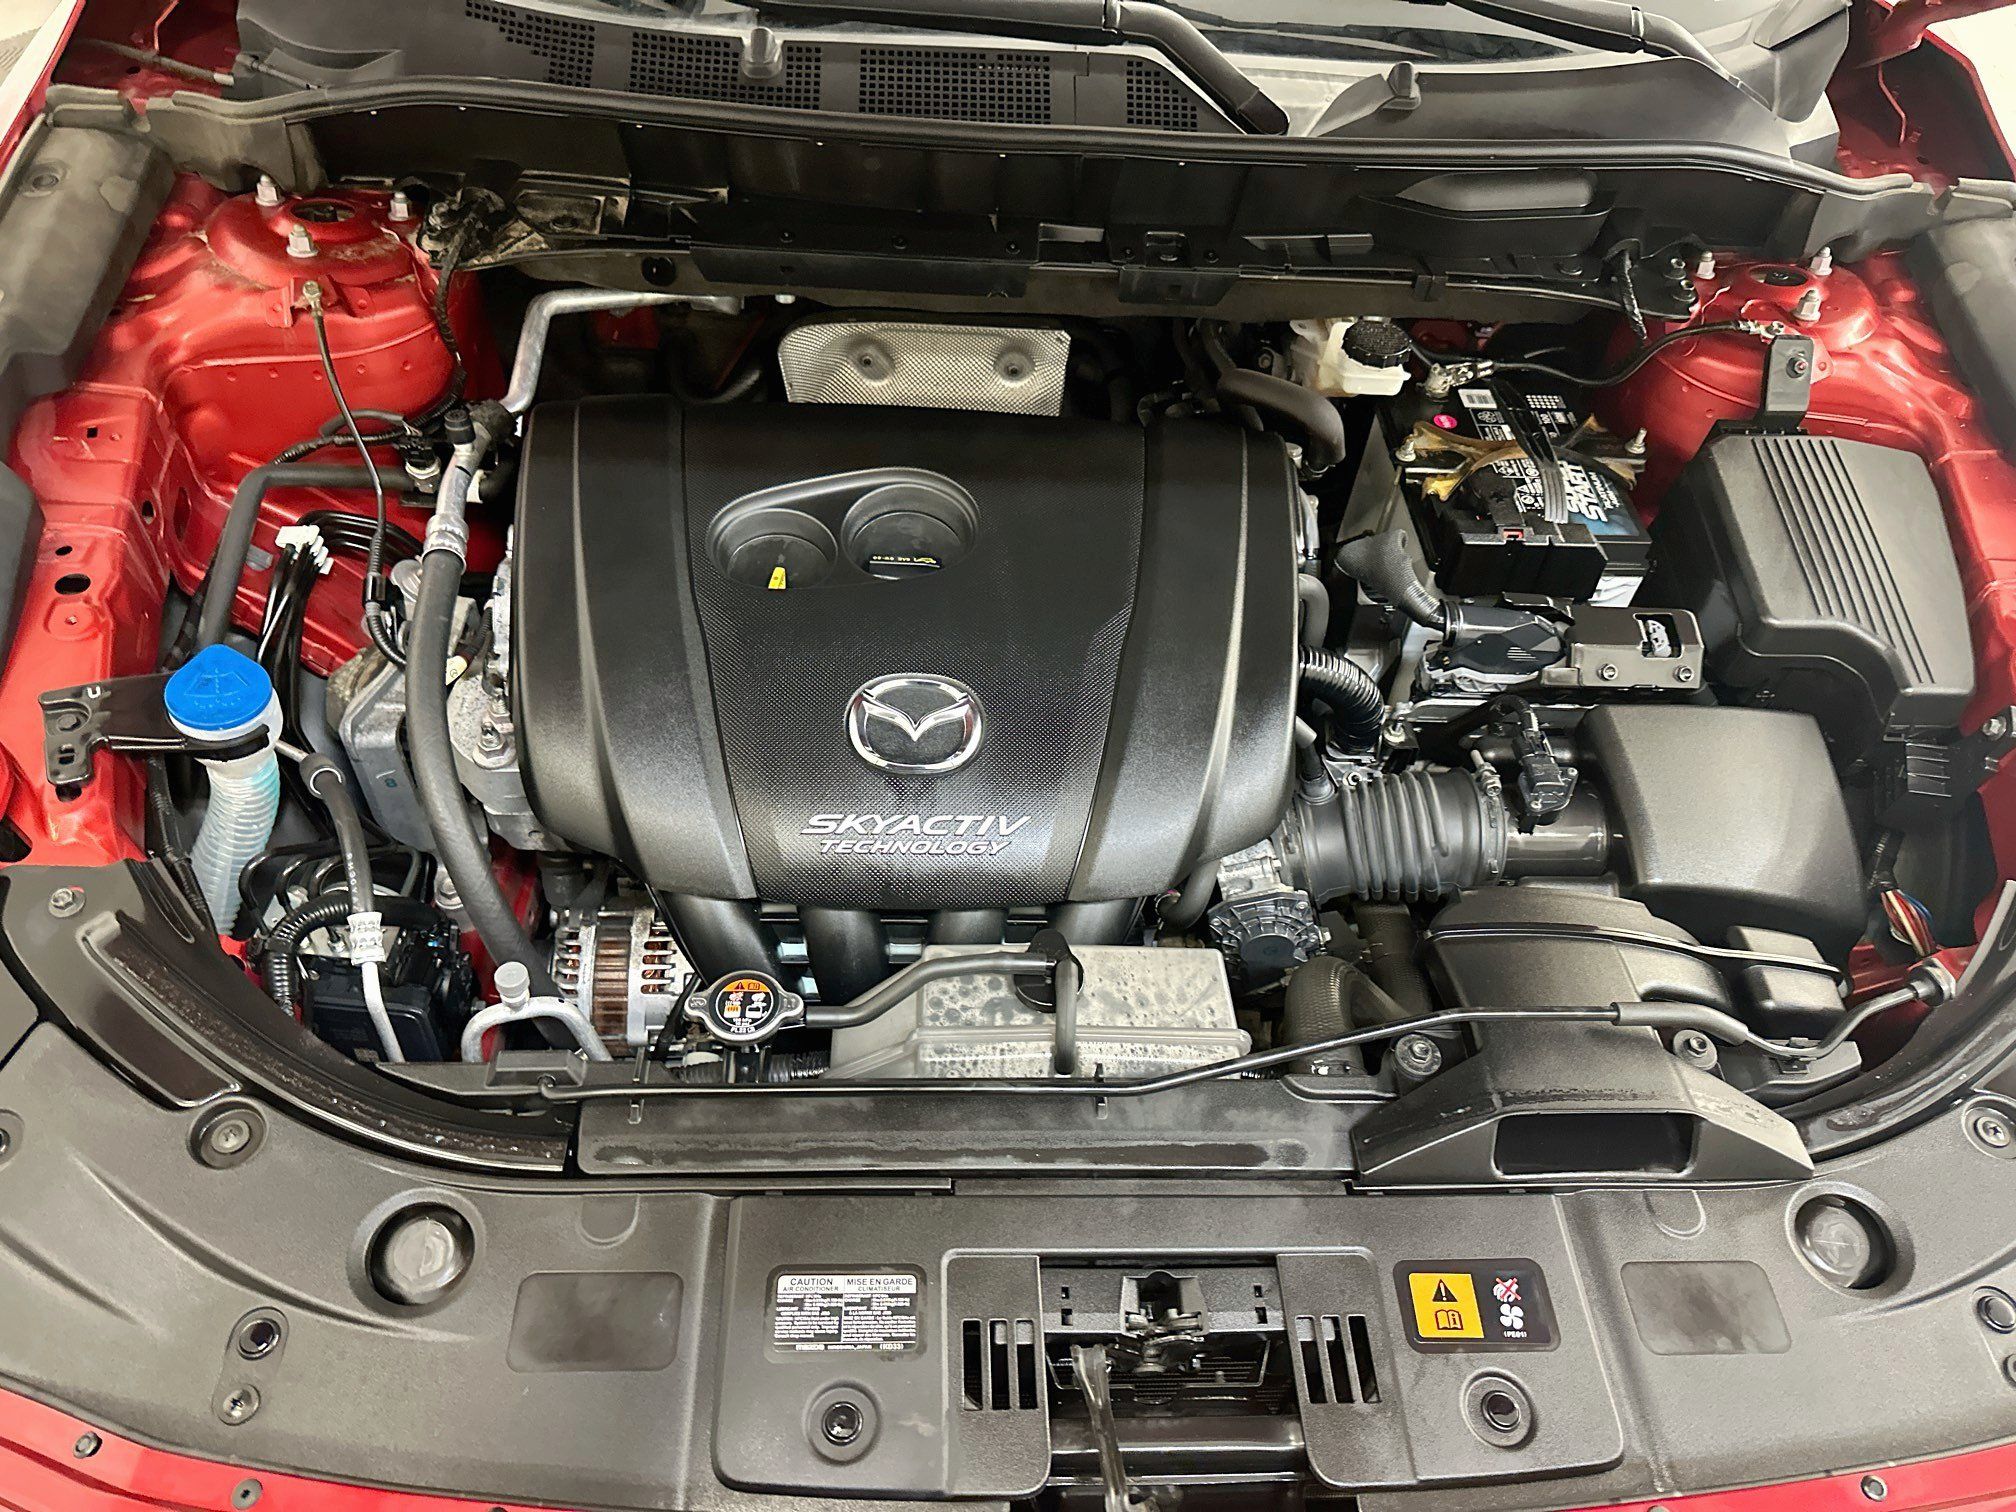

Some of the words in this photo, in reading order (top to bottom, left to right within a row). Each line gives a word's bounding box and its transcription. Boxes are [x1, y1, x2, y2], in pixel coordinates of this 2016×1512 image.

[1566, 464, 1608, 522] START
[800, 813, 1031, 836] SKYACTIV
[820, 839, 1012, 855] TECHNOLOGY
[790, 1277, 833, 1286] CAUTION
[846, 1278, 868, 1286] MISE
[869, 1278, 881, 1286] EN
[882, 1277, 914, 1286] GARDE
